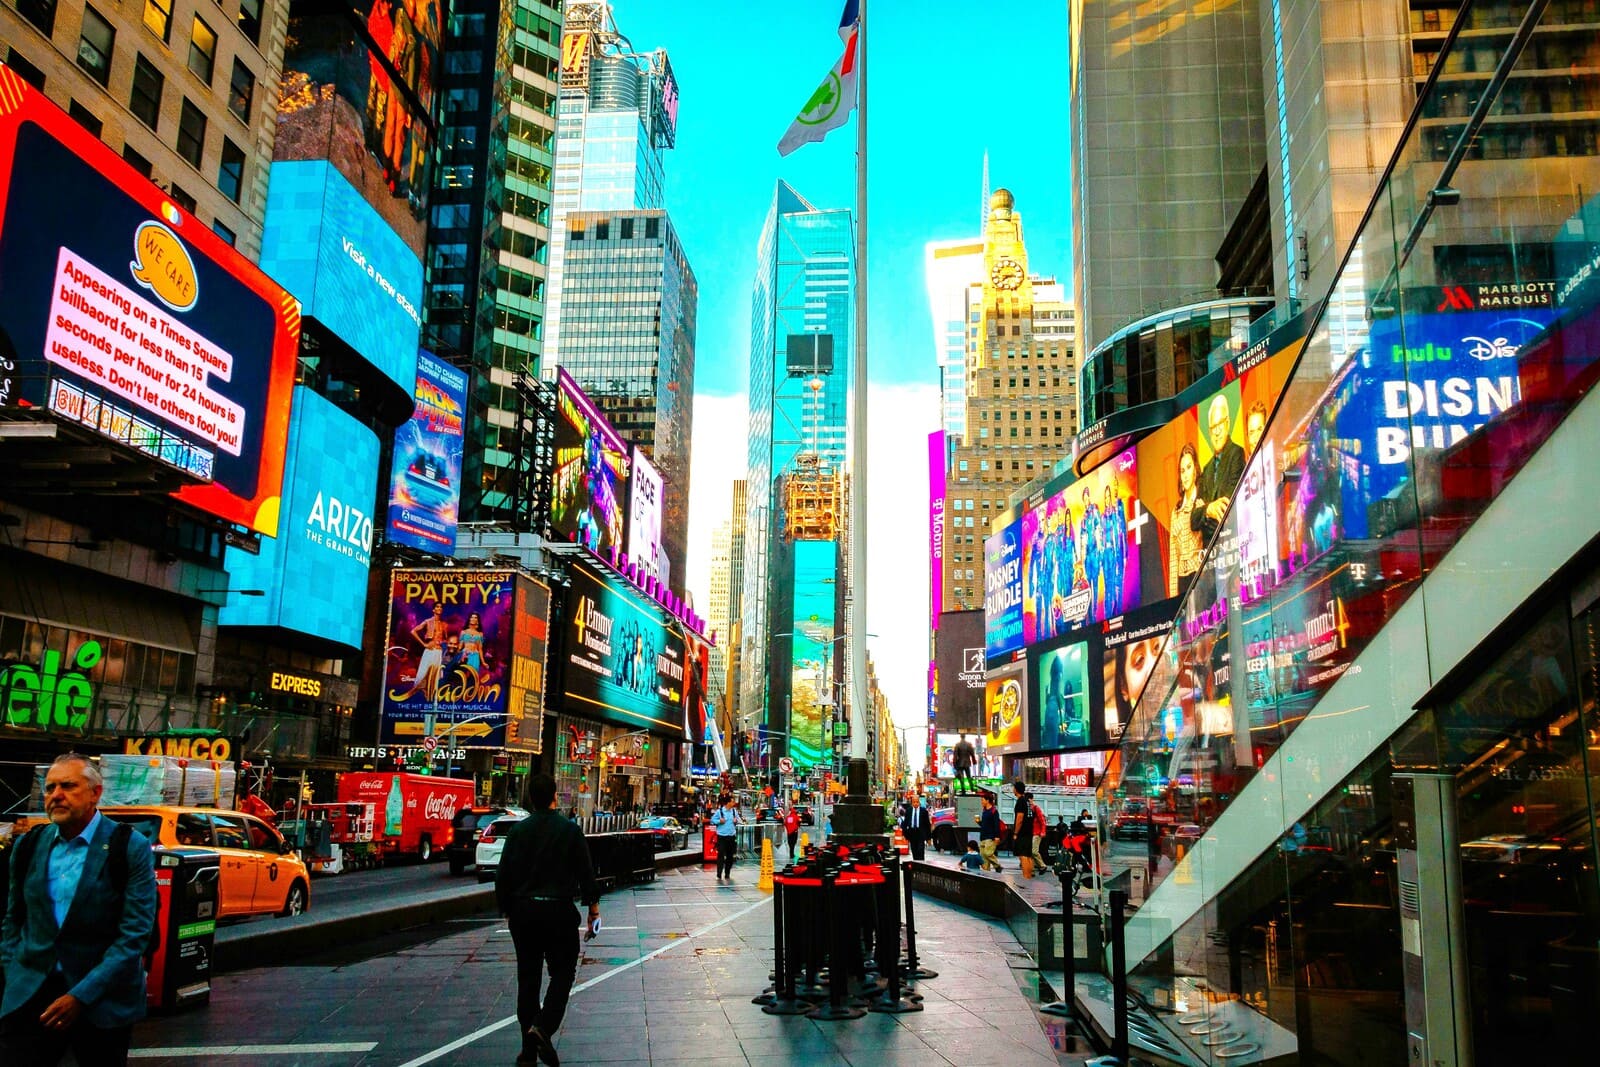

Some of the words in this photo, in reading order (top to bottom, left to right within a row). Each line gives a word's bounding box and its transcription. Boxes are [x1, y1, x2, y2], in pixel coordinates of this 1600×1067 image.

[145, 232, 164, 264] WE
[165, 260, 190, 298] CARE
[342, 236, 367, 271] Visit
[367, 264, 375, 278] a
[375, 271, 396, 297] new
[396, 292, 417, 322] state
[1479, 282, 1556, 295] MARRIOTT
[1480, 294, 1548, 306] MARQUIS
[60, 284, 119, 332] billbaord
[121, 321, 138, 342] for
[140, 333, 162, 357] less
[165, 348, 189, 373] than
[191, 365, 204, 381] 15
[64, 260, 131, 316] Appearing
[133, 306, 148, 324] on
[150, 317, 157, 329] a
[160, 319, 191, 350] Times
[193, 342, 228, 373] Square
[1237, 337, 1271, 364] MARRIOTT
[1238, 351, 1268, 374] MARQUIS
[1392, 342, 1452, 363] hulu
[1461, 336, 1523, 361] Dis
[56, 315, 112, 354] seconds
[114, 347, 135, 367] per
[136, 358, 164, 382] hour
[165, 374, 181, 393] for
[182, 383, 197, 402] 24
[198, 392, 226, 418] hours
[227, 408, 236, 424] is
[52, 340, 107, 380] useless.
[109, 367, 142, 397] Don't
[143, 386, 159, 406] let
[160, 400, 195, 425] others
[197, 416, 216, 436] fool
[217, 428, 238, 448] you!
[1376, 423, 1485, 465] BUN
[635, 465, 656, 507] FACE
[307, 490, 374, 556] ARIZO
[306, 528, 323, 545] THE
[326, 538, 353, 557] GRAND
[396, 572, 463, 583] BROADWAY'S
[466, 573, 511, 583] BIGGEST
[988, 557, 1020, 592] DISNEY
[405, 583, 501, 605] PARTY!
[987, 582, 1022, 617] BUNDLE
[574, 595, 586, 644] 4
[586, 598, 615, 645] Emmy
[272, 672, 321, 698] EXPRESS
[388, 664, 502, 703] Aladdin
[958, 672, 982, 683] Simon
[398, 703, 410, 711] THE
[423, 703, 462, 711] BRADWAY
[463, 703, 493, 711] MUSICAL
[124, 737, 231, 761] KAMCO
[397, 748, 466, 760] LUAGE
